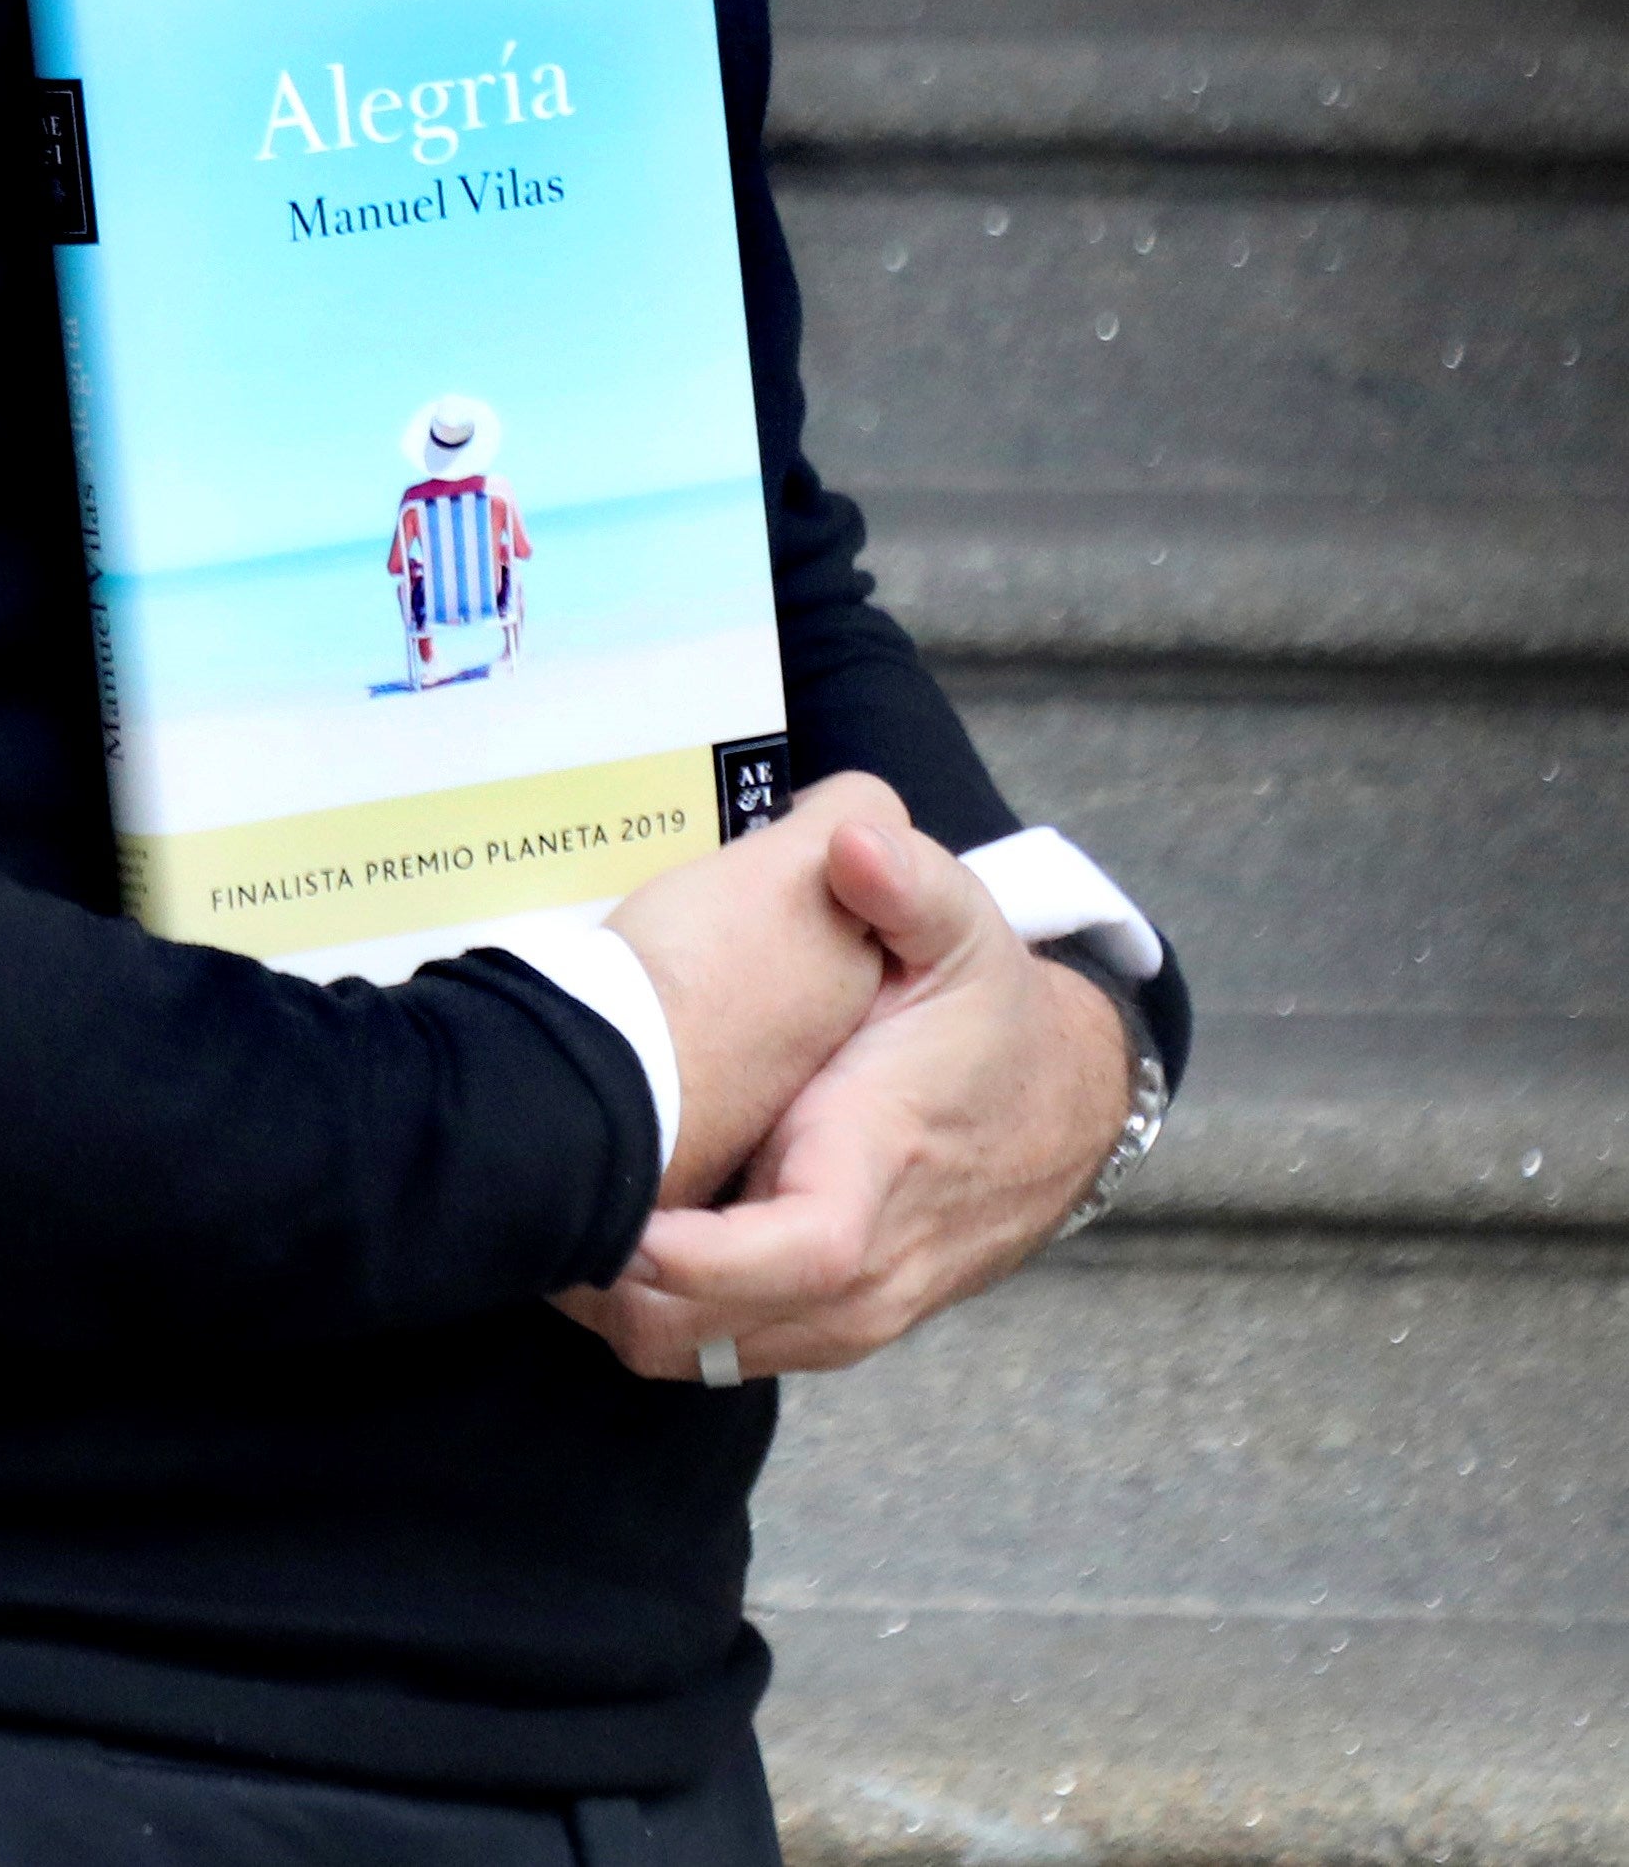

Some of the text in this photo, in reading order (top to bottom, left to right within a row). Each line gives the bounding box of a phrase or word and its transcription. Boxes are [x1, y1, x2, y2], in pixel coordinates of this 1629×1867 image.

[254, 40, 576, 166] Alegría
[287, 168, 566, 242] Manuel Vilas
[211, 809, 687, 913] FINALISTA PREMIO PLANETA 2019
